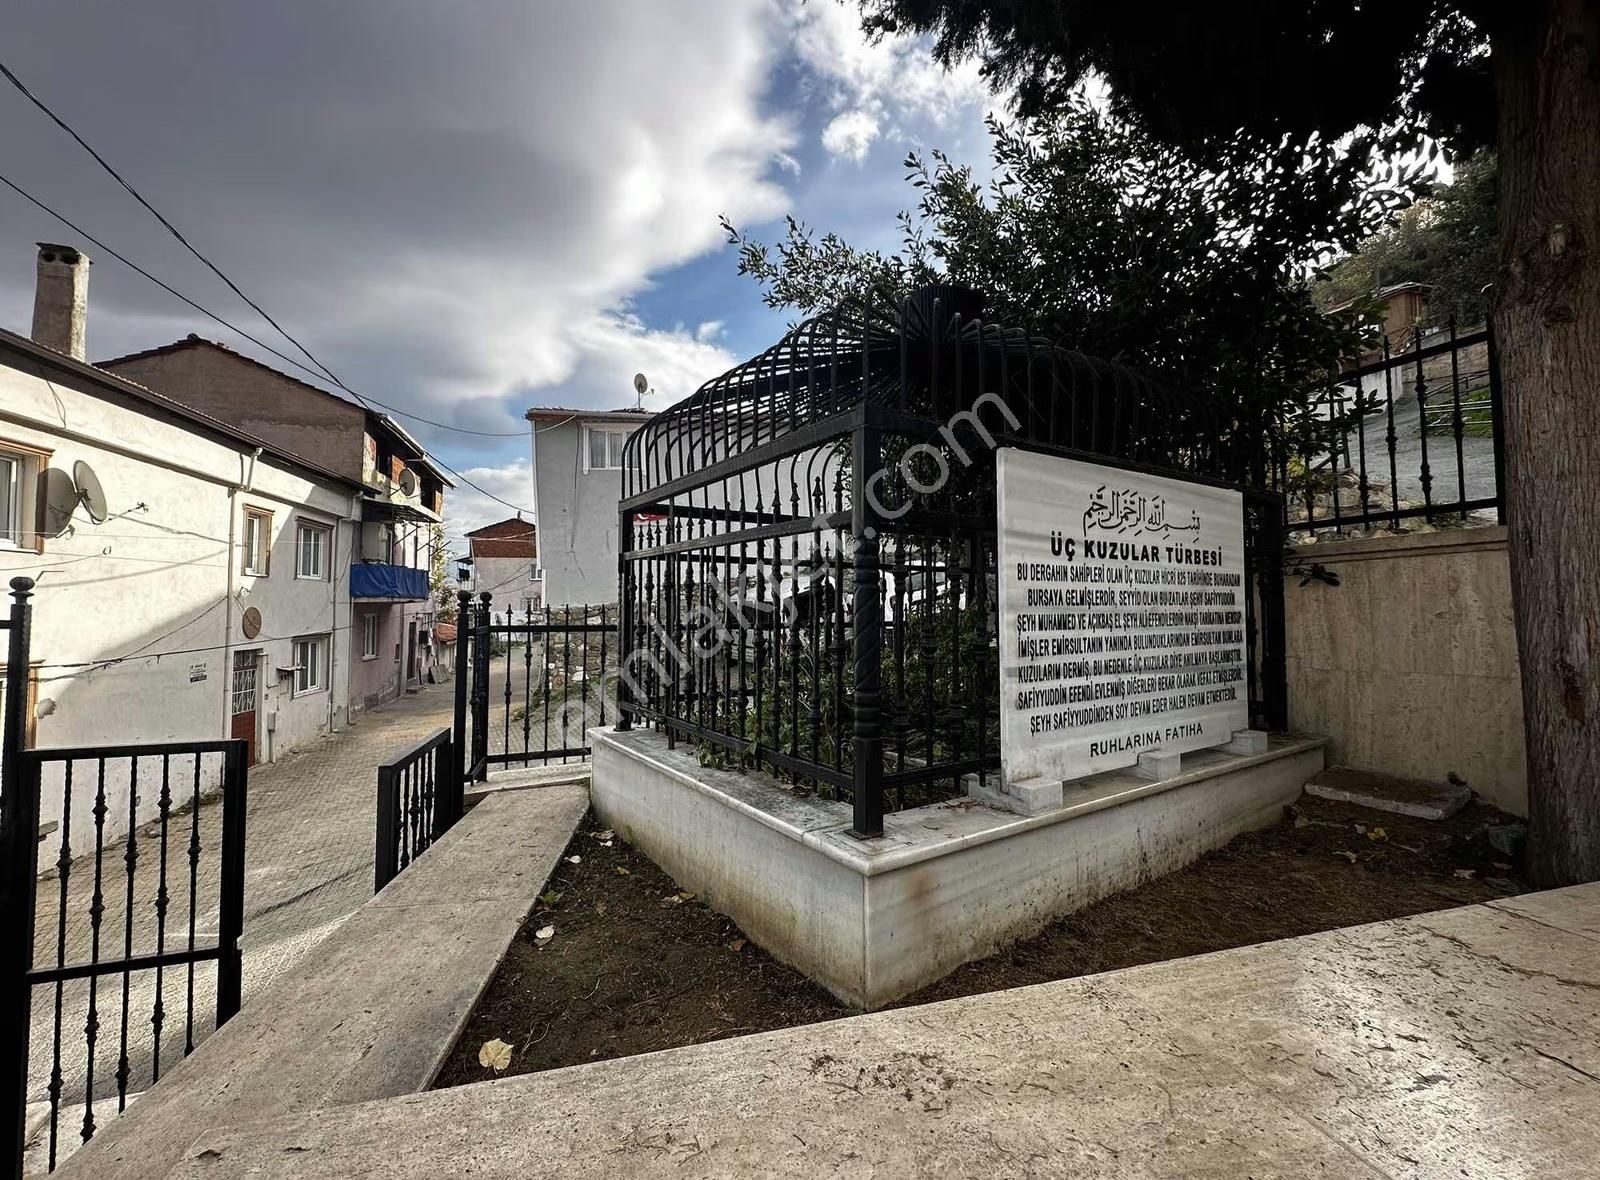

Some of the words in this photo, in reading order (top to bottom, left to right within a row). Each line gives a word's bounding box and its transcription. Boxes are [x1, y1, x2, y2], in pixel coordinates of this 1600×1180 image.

[1050, 531, 1076, 562] ÜÇ
[1083, 538, 1160, 563] KUZULAR
[1166, 543, 1222, 567] TÜRBESİ
[1017, 563, 1028, 580] BU
[1030, 563, 1068, 582] DERGAHIN
[1070, 562, 1105, 582] SAHİPLERİ
[1106, 567, 1123, 583] OLAN
[1124, 565, 1133, 587] ÜÇ
[1134, 569, 1160, 585] KUZULAR
[1028, 588, 1063, 606] BURSAYA
[1119, 587, 1141, 606] SEYYİD
[1143, 590, 1158, 606] OLAN
[1160, 591, 1168, 606] BU
[1168, 591, 1188, 606] ZATLAR
[1017, 613, 1036, 636] ŞEYH
[1038, 613, 1076, 631] MUHAMMED
[1077, 613, 1086, 630] VE
[1087, 612, 1113, 633] AÇIKBAŞ
[1114, 612, 1122, 629] EL
[1123, 612, 1138, 632] ŞEYH
[1139, 609, 1148, 628] ALİ
[1018, 636, 1050, 661] İMİŞLER
[1104, 635, 1132, 653] YANINDA
[1018, 663, 1061, 684] KUZULARIM
[1093, 660, 1102, 676] BU
[1104, 657, 1132, 675] NEDENLE
[1133, 653, 1143, 675] ÜÇ
[1143, 655, 1169, 671] KUZULAR
[1169, 651, 1182, 668] DİYE
[1018, 684, 1067, 710] SAFİYYUDDİN
[1069, 681, 1094, 704] EFENDİ
[1095, 678, 1126, 700] EVLENMİŞ
[1126, 674, 1157, 696] DİĞERLERİ
[1158, 674, 1176, 692] BEKAR
[1176, 672, 1196, 689] OLARAK
[1196, 670, 1212, 686] VEFAT
[1030, 714, 1051, 737] ŞEYH
[1053, 704, 1114, 730] SAFİYYUDDİNDEN
[1115, 703, 1129, 720] SOY
[1130, 700, 1151, 718] DEVAM
[1152, 697, 1168, 714] EDER
[1168, 693, 1187, 711] HALEN
[1187, 691, 1206, 708] DEVAM
[1090, 730, 1161, 758] RUHLARINA
[1165, 722, 1203, 741] FATIHA
